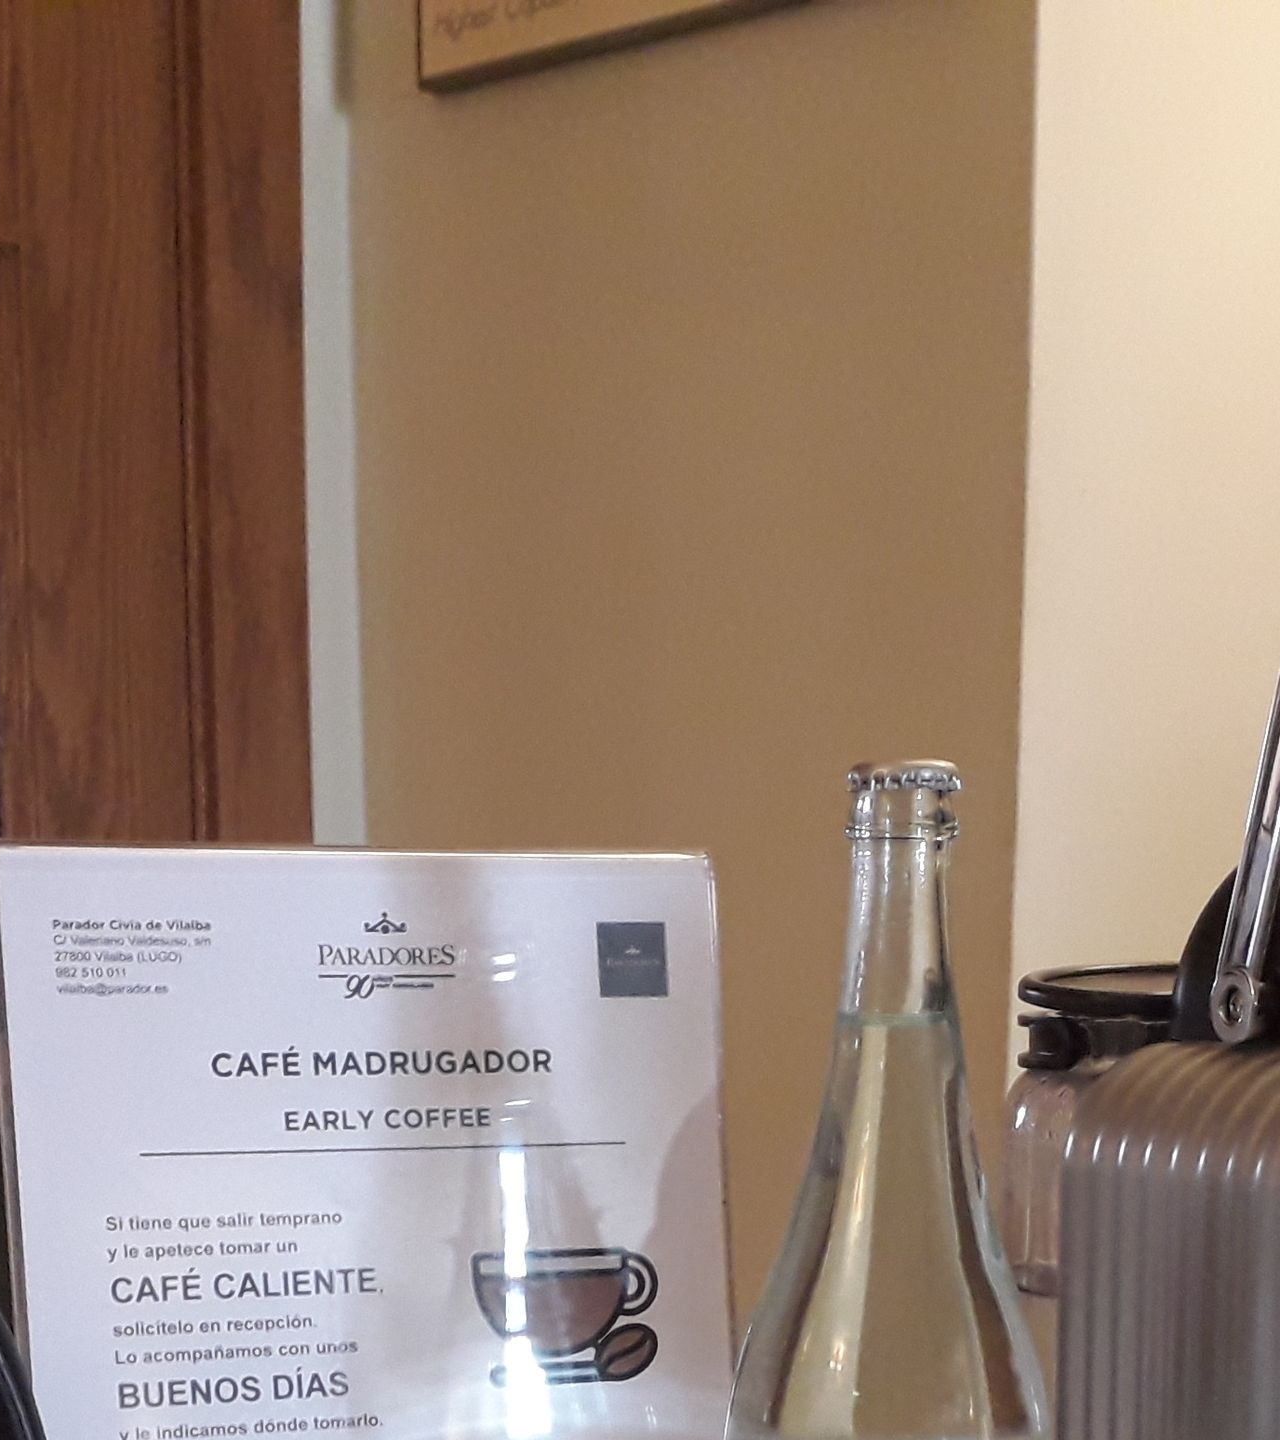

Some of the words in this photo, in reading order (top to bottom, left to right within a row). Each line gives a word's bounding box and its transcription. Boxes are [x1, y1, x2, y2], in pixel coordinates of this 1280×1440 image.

[52, 919, 105, 931] Parador
[146, 919, 162, 931] de
[166, 919, 211, 931] Vilalba
[137, 950, 182, 963] (LUGO)
[318, 943, 455, 967] PARADORES
[55, 967, 77, 978] 982
[81, 967, 103, 978] 510
[107, 967, 126, 978] 011
[211, 1046, 301, 1078] CAFÉ
[312, 1049, 552, 1077] MADRUGADOR
[284, 1110, 374, 1131] EARLY
[384, 1107, 491, 1129] COFFEE
[106, 1216, 122, 1231] Si
[129, 1216, 172, 1231] tiene
[179, 1216, 210, 1232] que
[216, 1212, 253, 1228] salir
[260, 1211, 342, 1229] temprano
[107, 1247, 117, 1263] y
[124, 1244, 138, 1259] le
[145, 1244, 214, 1262] apetece
[219, 1240, 270, 1256] tomar
[277, 1240, 298, 1254] un
[111, 1267, 202, 1303] CAFÉ
[213, 1268, 384, 1300] CALIENTE,
[113, 1318, 193, 1337] solicítelo
[200, 1320, 220, 1334] en
[227, 1315, 317, 1334] recepción.
[115, 1350, 137, 1365] Lo
[144, 1345, 271, 1363] acompañamos
[279, 1342, 310, 1356] con
[316, 1340, 359, 1355] unos
[118, 1376, 261, 1409] BUENOS
[272, 1366, 349, 1400] DÍAS
[135, 1427, 150, 1440] le
[156, 1422, 247, 1440] indicamos
[254, 1417, 308, 1434] dónde
[314, 1413, 383, 1431] tomarlo.
